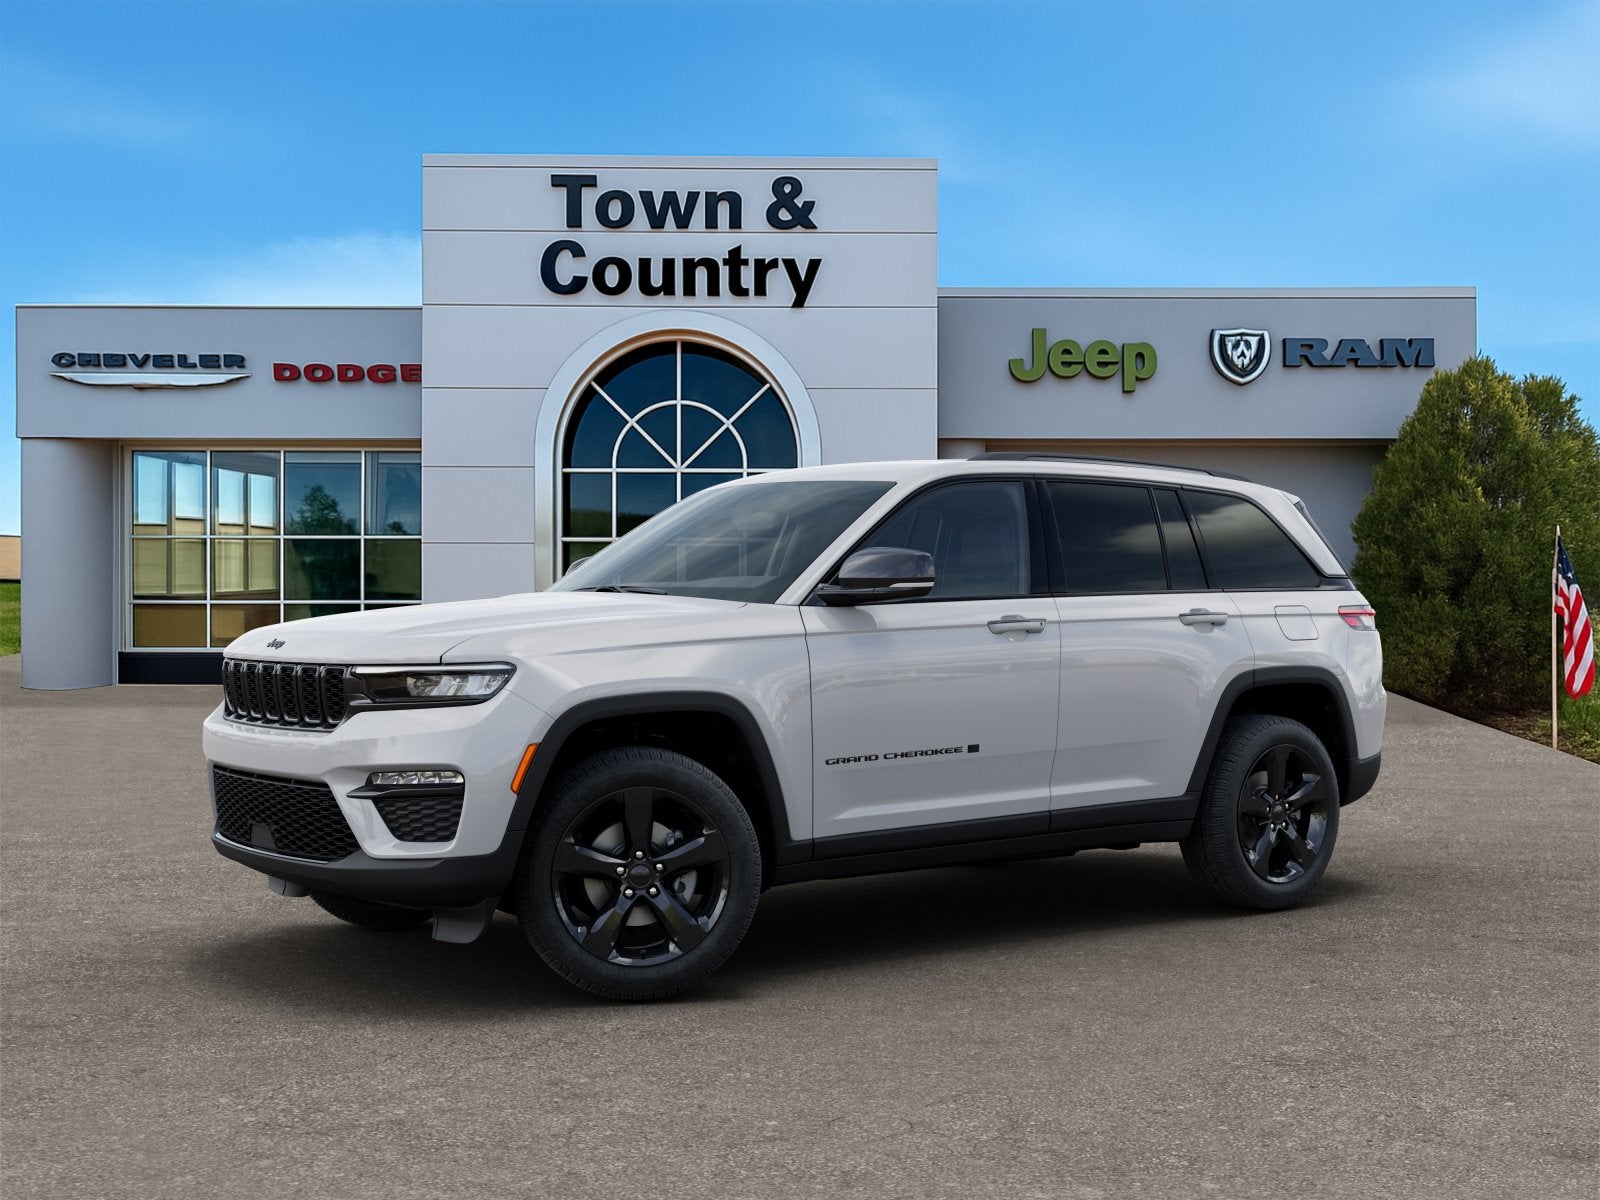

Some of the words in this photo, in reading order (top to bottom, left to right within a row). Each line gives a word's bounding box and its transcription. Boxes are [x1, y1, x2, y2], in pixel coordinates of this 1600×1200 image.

[551, 174, 742, 229] Town
[765, 176, 818, 230] &
[540, 239, 822, 308] Country
[273, 363, 422, 383] DODGE
[1009, 328, 1157, 393] Jeep
[1283, 337, 1435, 367] RAM
[825, 754, 879, 766] GRAND
[883, 746, 964, 760] CHEROKEE
